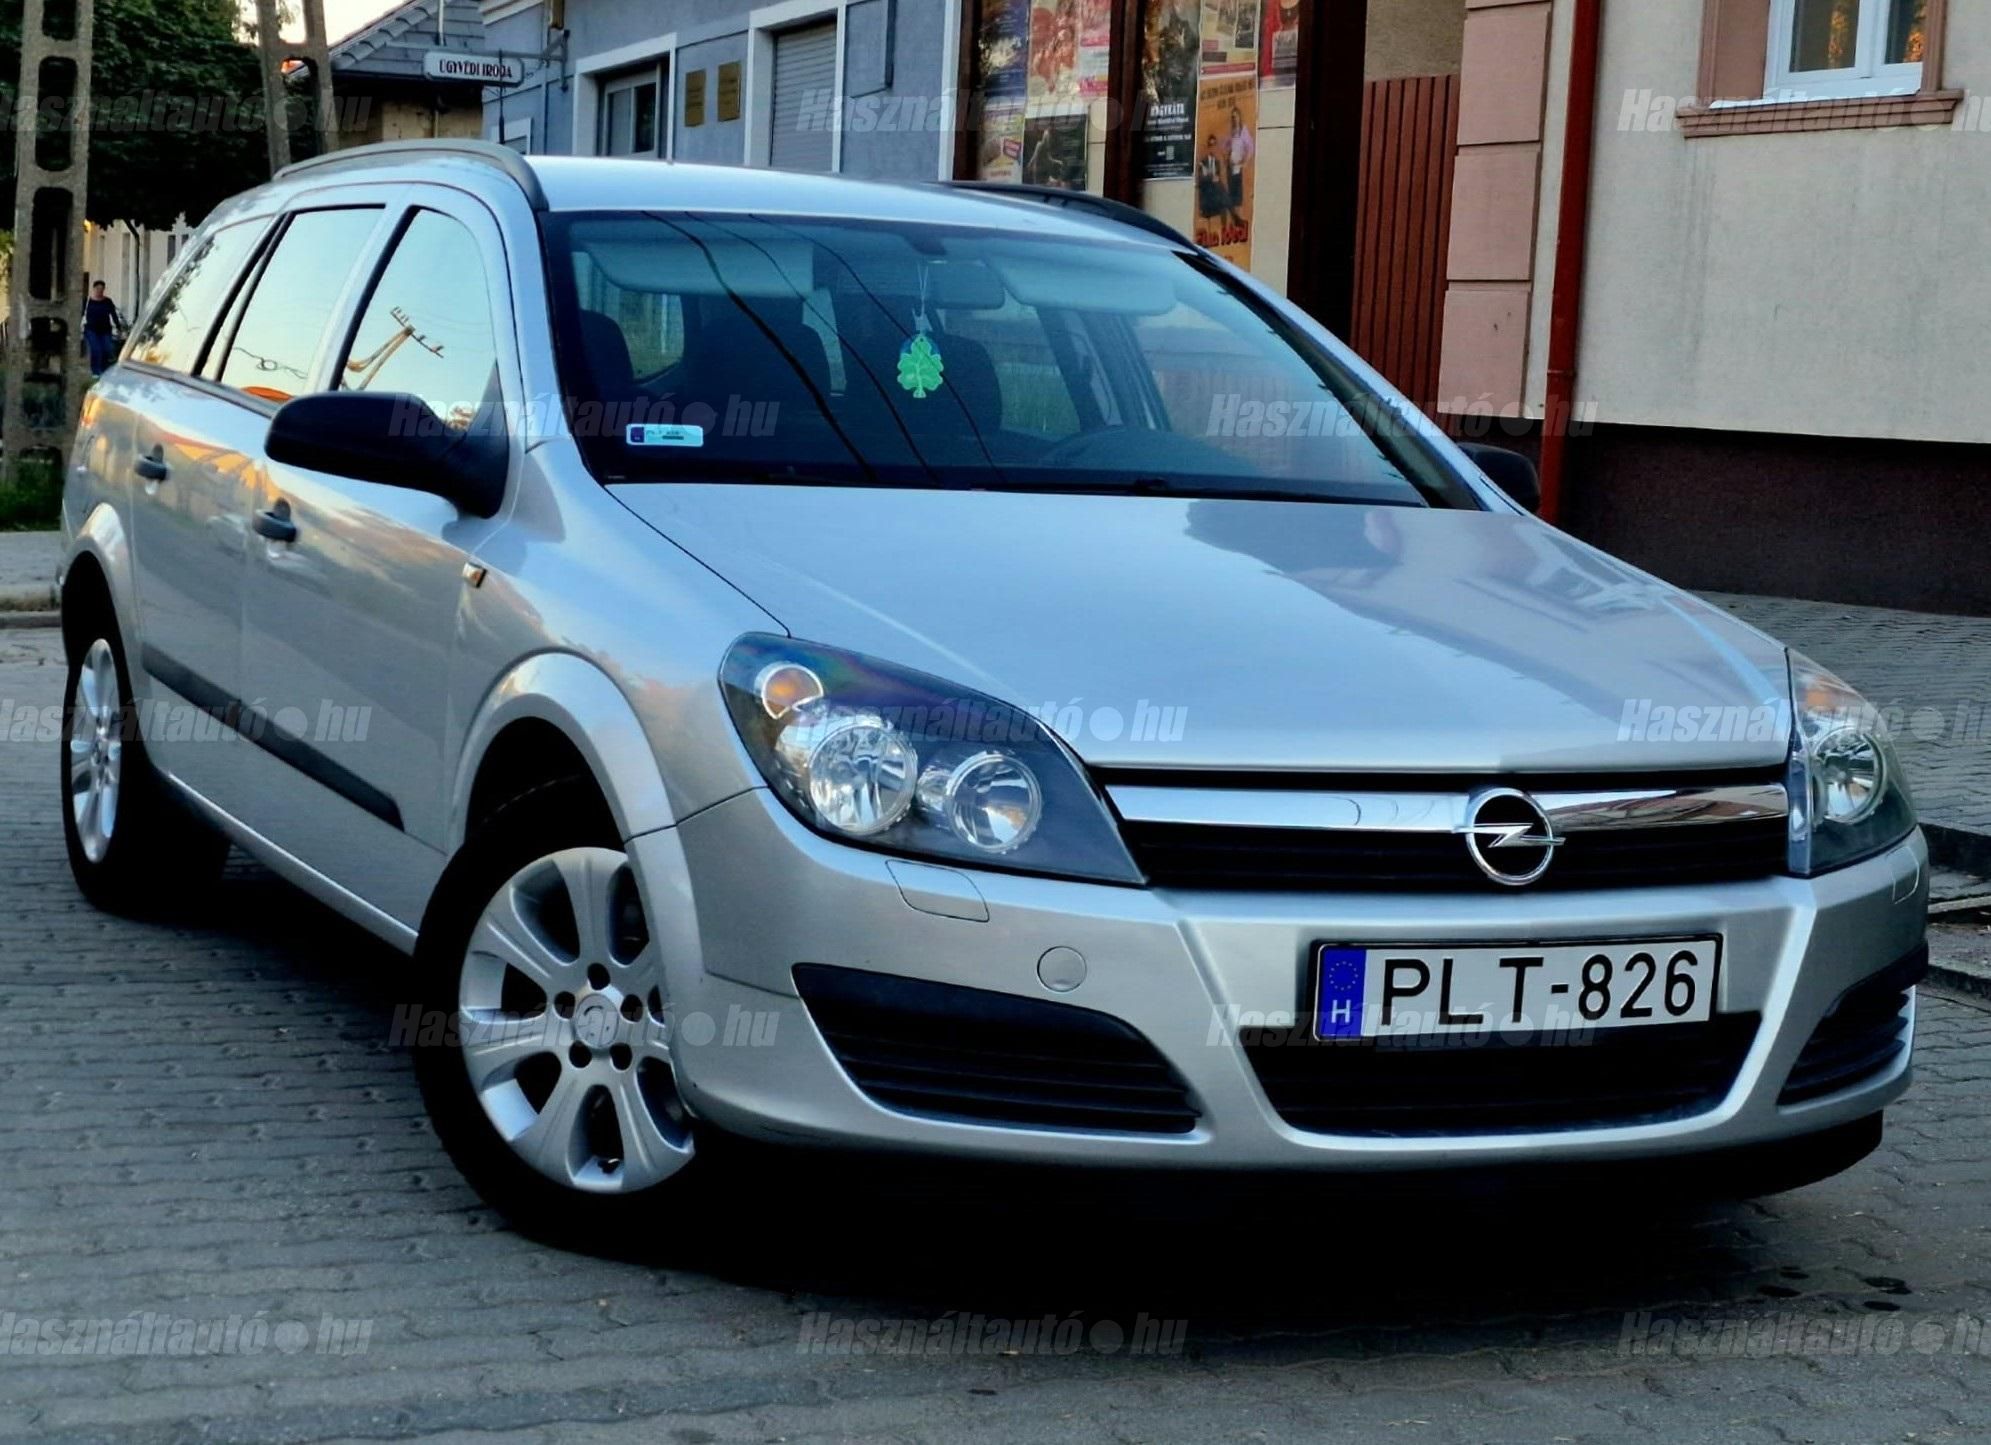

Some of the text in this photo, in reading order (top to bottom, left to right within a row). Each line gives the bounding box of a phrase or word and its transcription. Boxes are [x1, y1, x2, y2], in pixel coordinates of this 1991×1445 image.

[482, 62, 513, 78] IRODA
[1380, 950, 1699, 1026] PLT-826
[1330, 998, 1351, 1024] H
